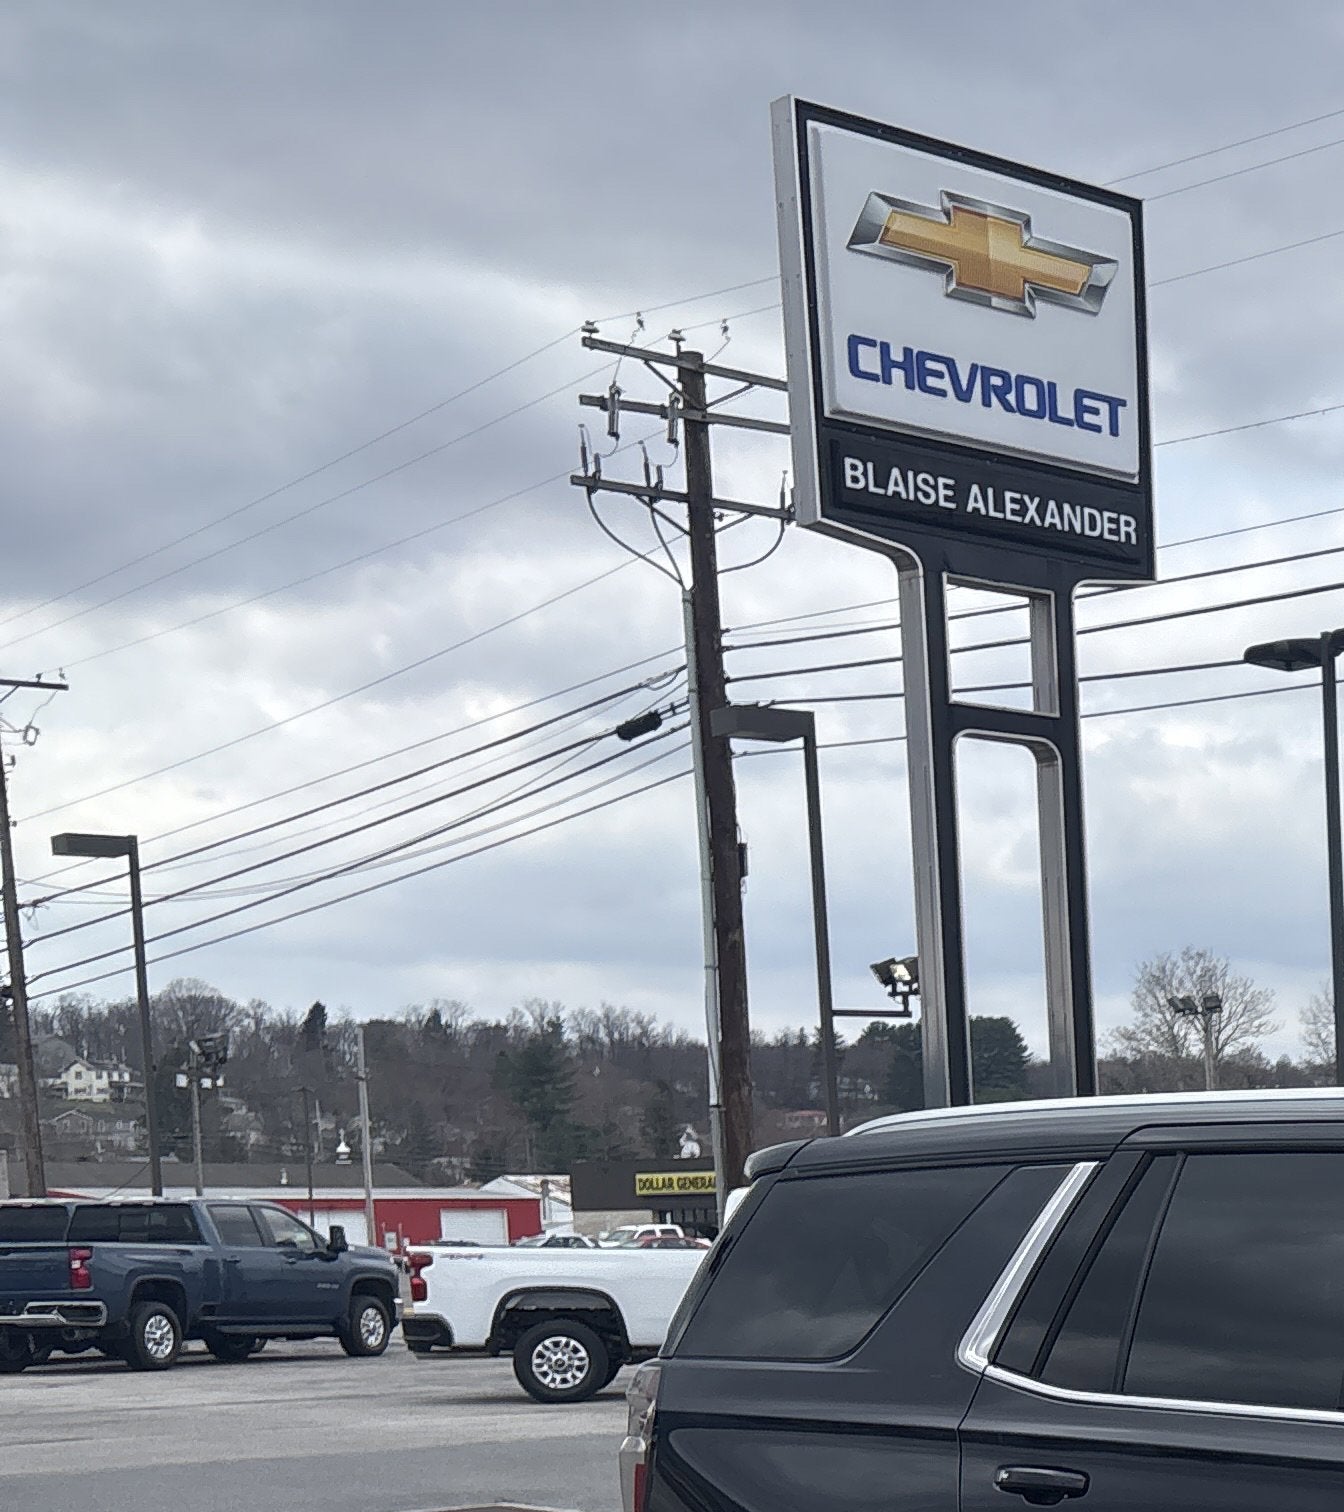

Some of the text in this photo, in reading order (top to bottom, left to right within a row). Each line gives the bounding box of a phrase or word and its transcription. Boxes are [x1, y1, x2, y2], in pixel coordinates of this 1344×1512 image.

[846, 333, 1127, 438] CHEVROLET
[843, 455, 1138, 546] BLAISE ALEXANDER
[638, 1175, 716, 1191] DOLLAR GENERA
